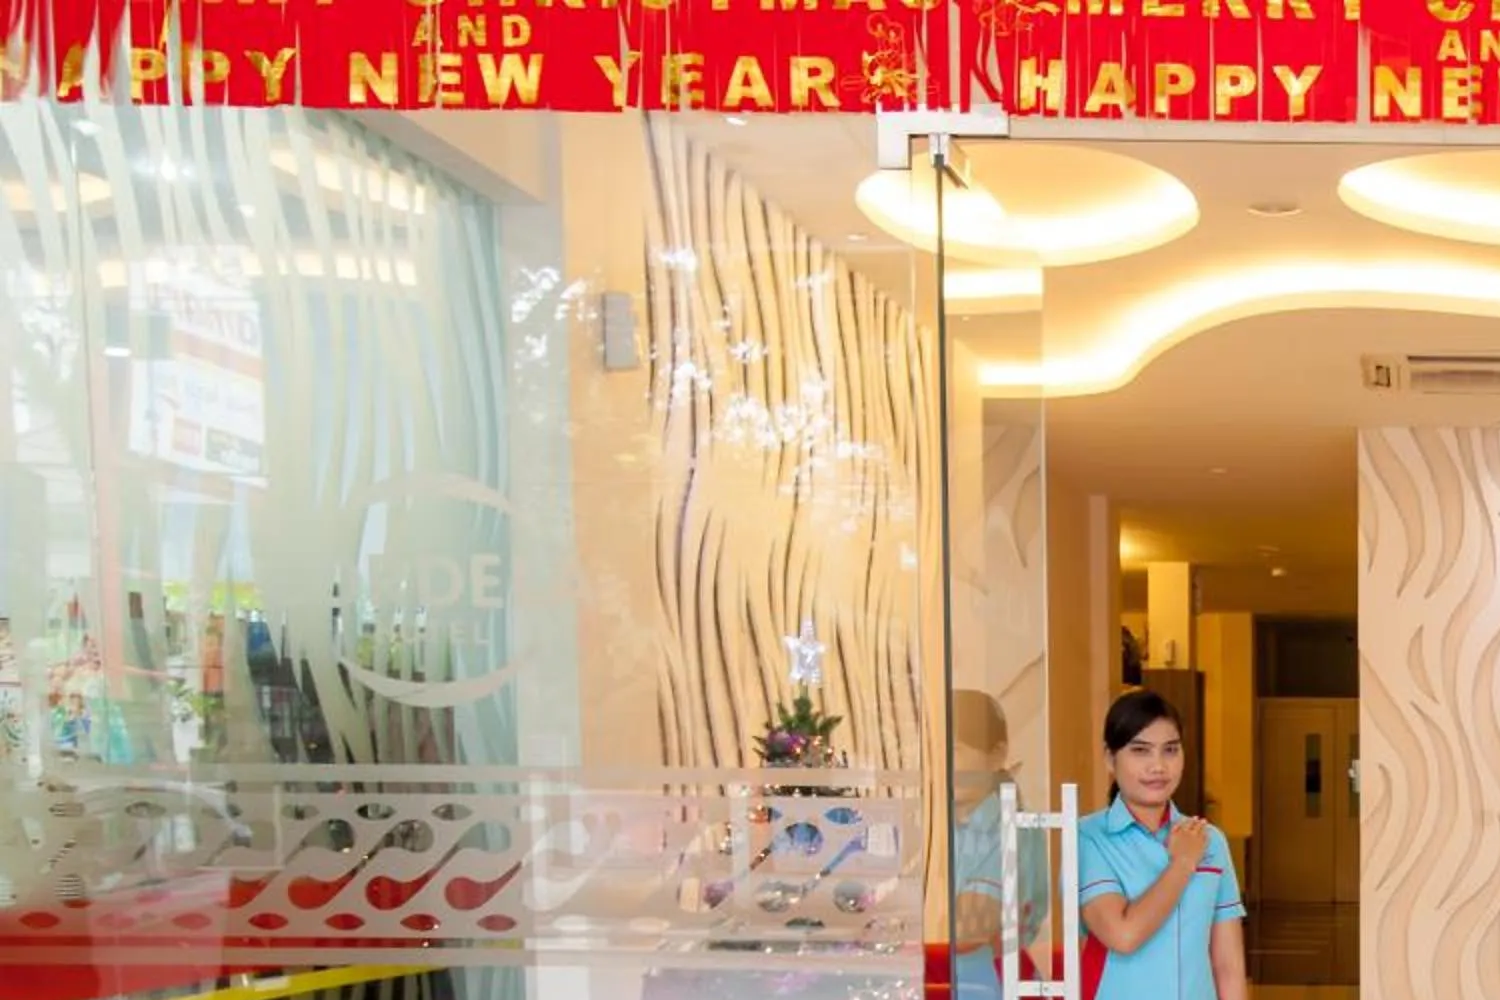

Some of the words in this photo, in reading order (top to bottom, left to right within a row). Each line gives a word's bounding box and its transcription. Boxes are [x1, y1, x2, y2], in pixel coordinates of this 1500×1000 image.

[412, 14, 531, 47] AND
[349, 52, 543, 104] NEW
[594, 50, 840, 107] YEAR
[1019, 57, 1323, 116] HAPPY
